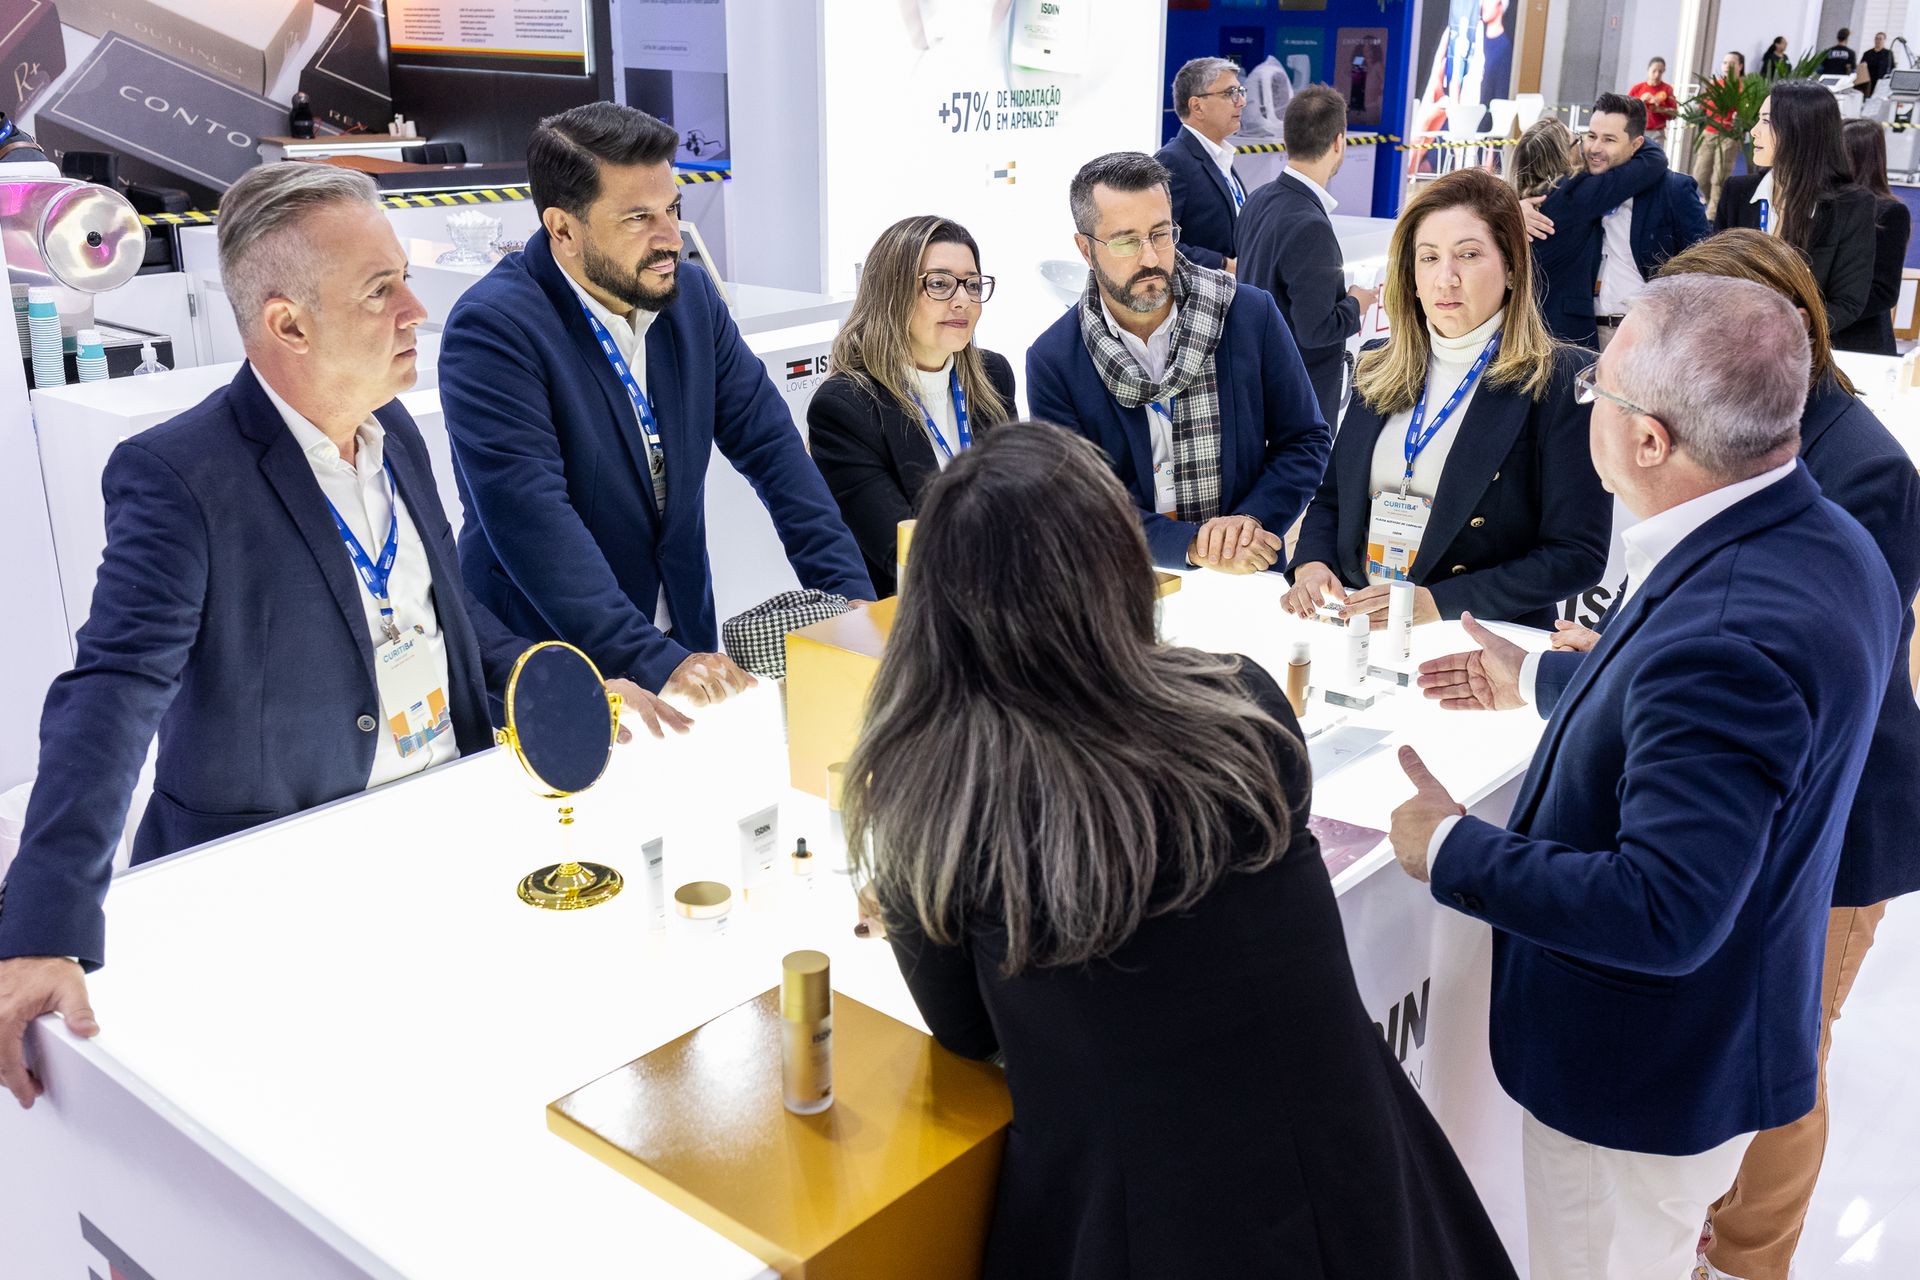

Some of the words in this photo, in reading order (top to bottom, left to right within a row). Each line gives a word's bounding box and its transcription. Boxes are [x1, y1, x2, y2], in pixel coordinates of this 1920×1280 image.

[1040, 3, 1060, 15] ISDIN
[996, 90, 1008, 108] DE
[1010, 85, 1061, 108] HIDRATAÇÃO
[938, 91, 991, 133] +57%
[996, 112, 1009, 130] EM
[1010, 111, 1043, 129] APENAS
[815, 354, 832, 375] IS
[786, 379, 808, 393] LOVE
[1384, 500, 1417, 511] CURITIBA
[383, 639, 415, 663] CURITIBA
[1373, 976, 1431, 1065] IN
